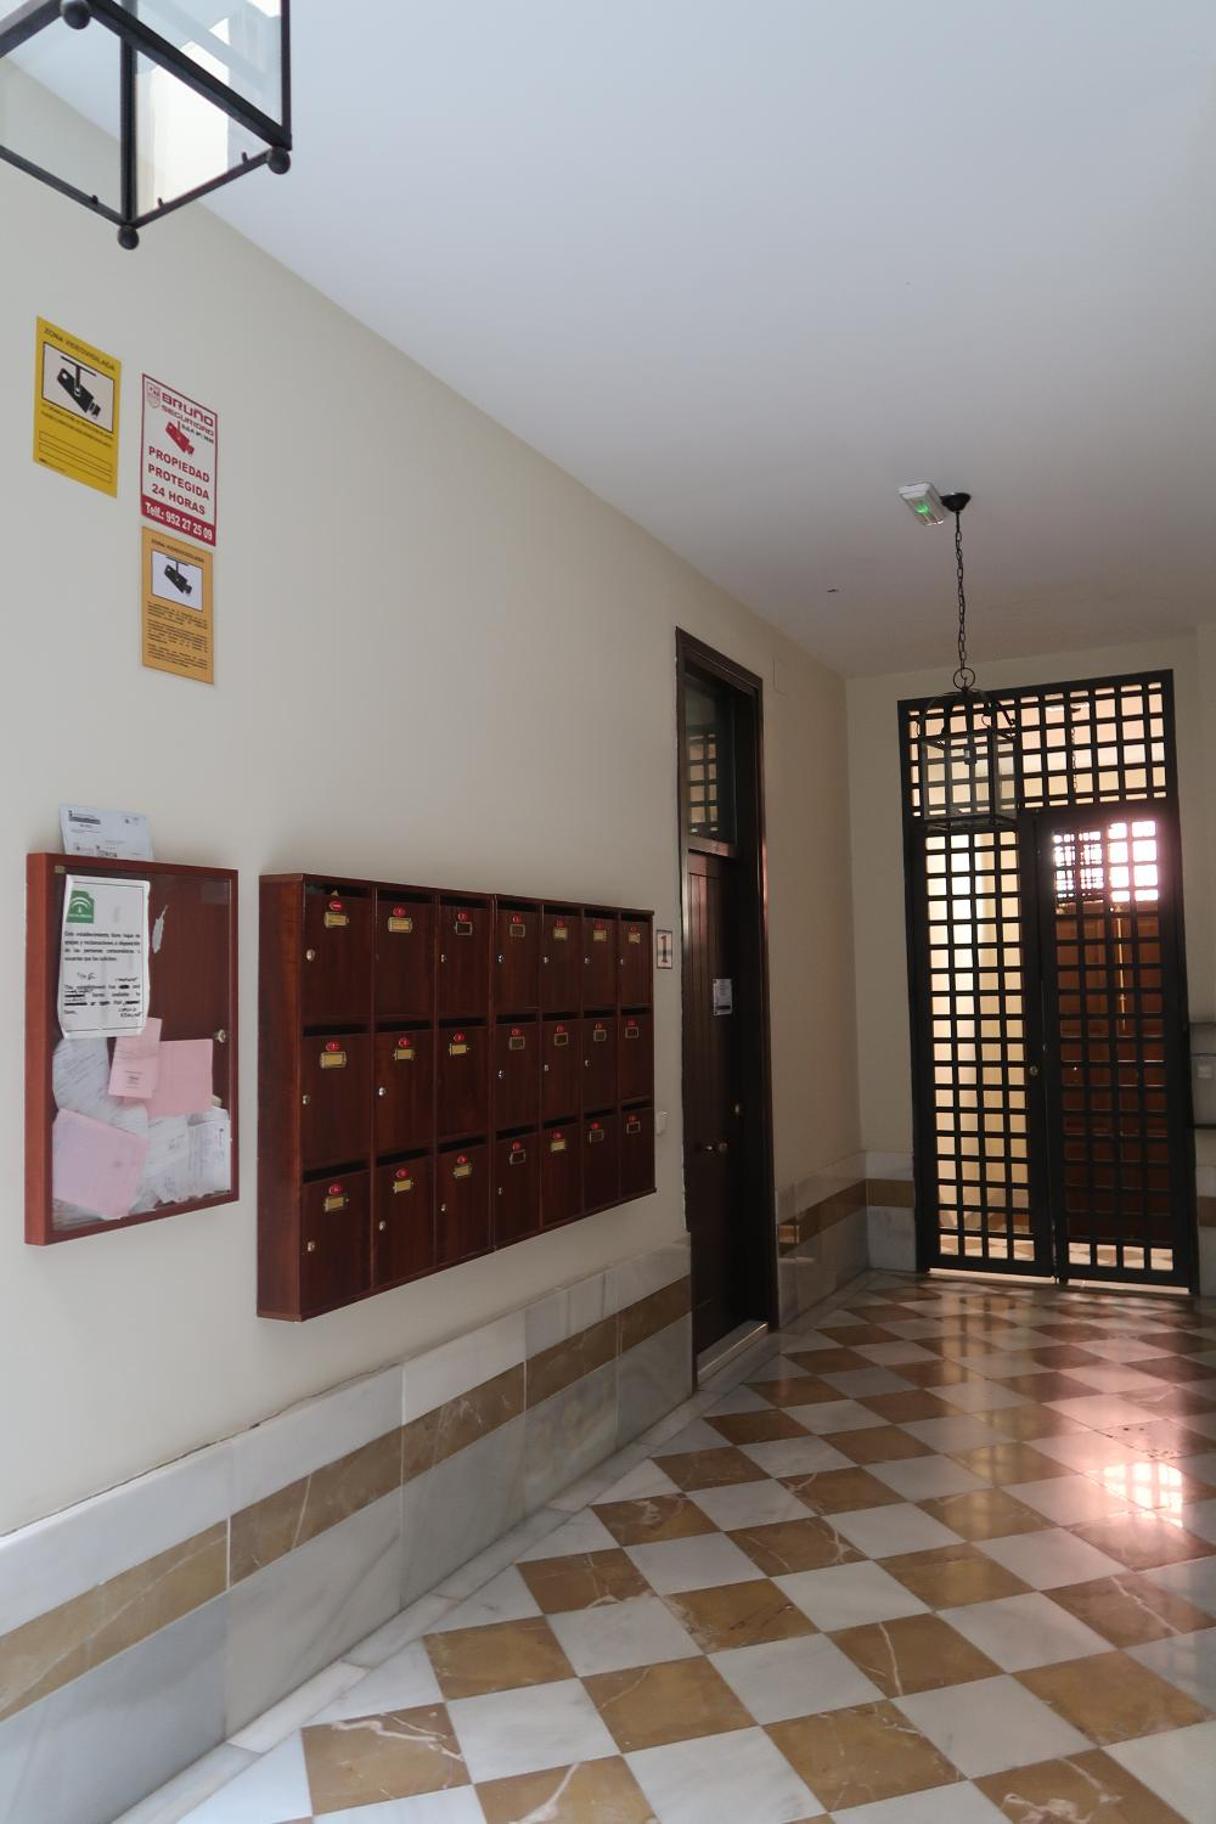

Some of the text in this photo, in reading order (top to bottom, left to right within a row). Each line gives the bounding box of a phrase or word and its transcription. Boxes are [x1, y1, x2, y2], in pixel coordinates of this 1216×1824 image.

[148, 445, 210, 483] PROPIEDAD
[147, 463, 210, 500] PROTEGIDA
[151, 483, 205, 515] 24 HORAS
[165, 511, 181, 527] 952
[192, 523, 203, 536] 25
[660, 934, 669, 964] 1
